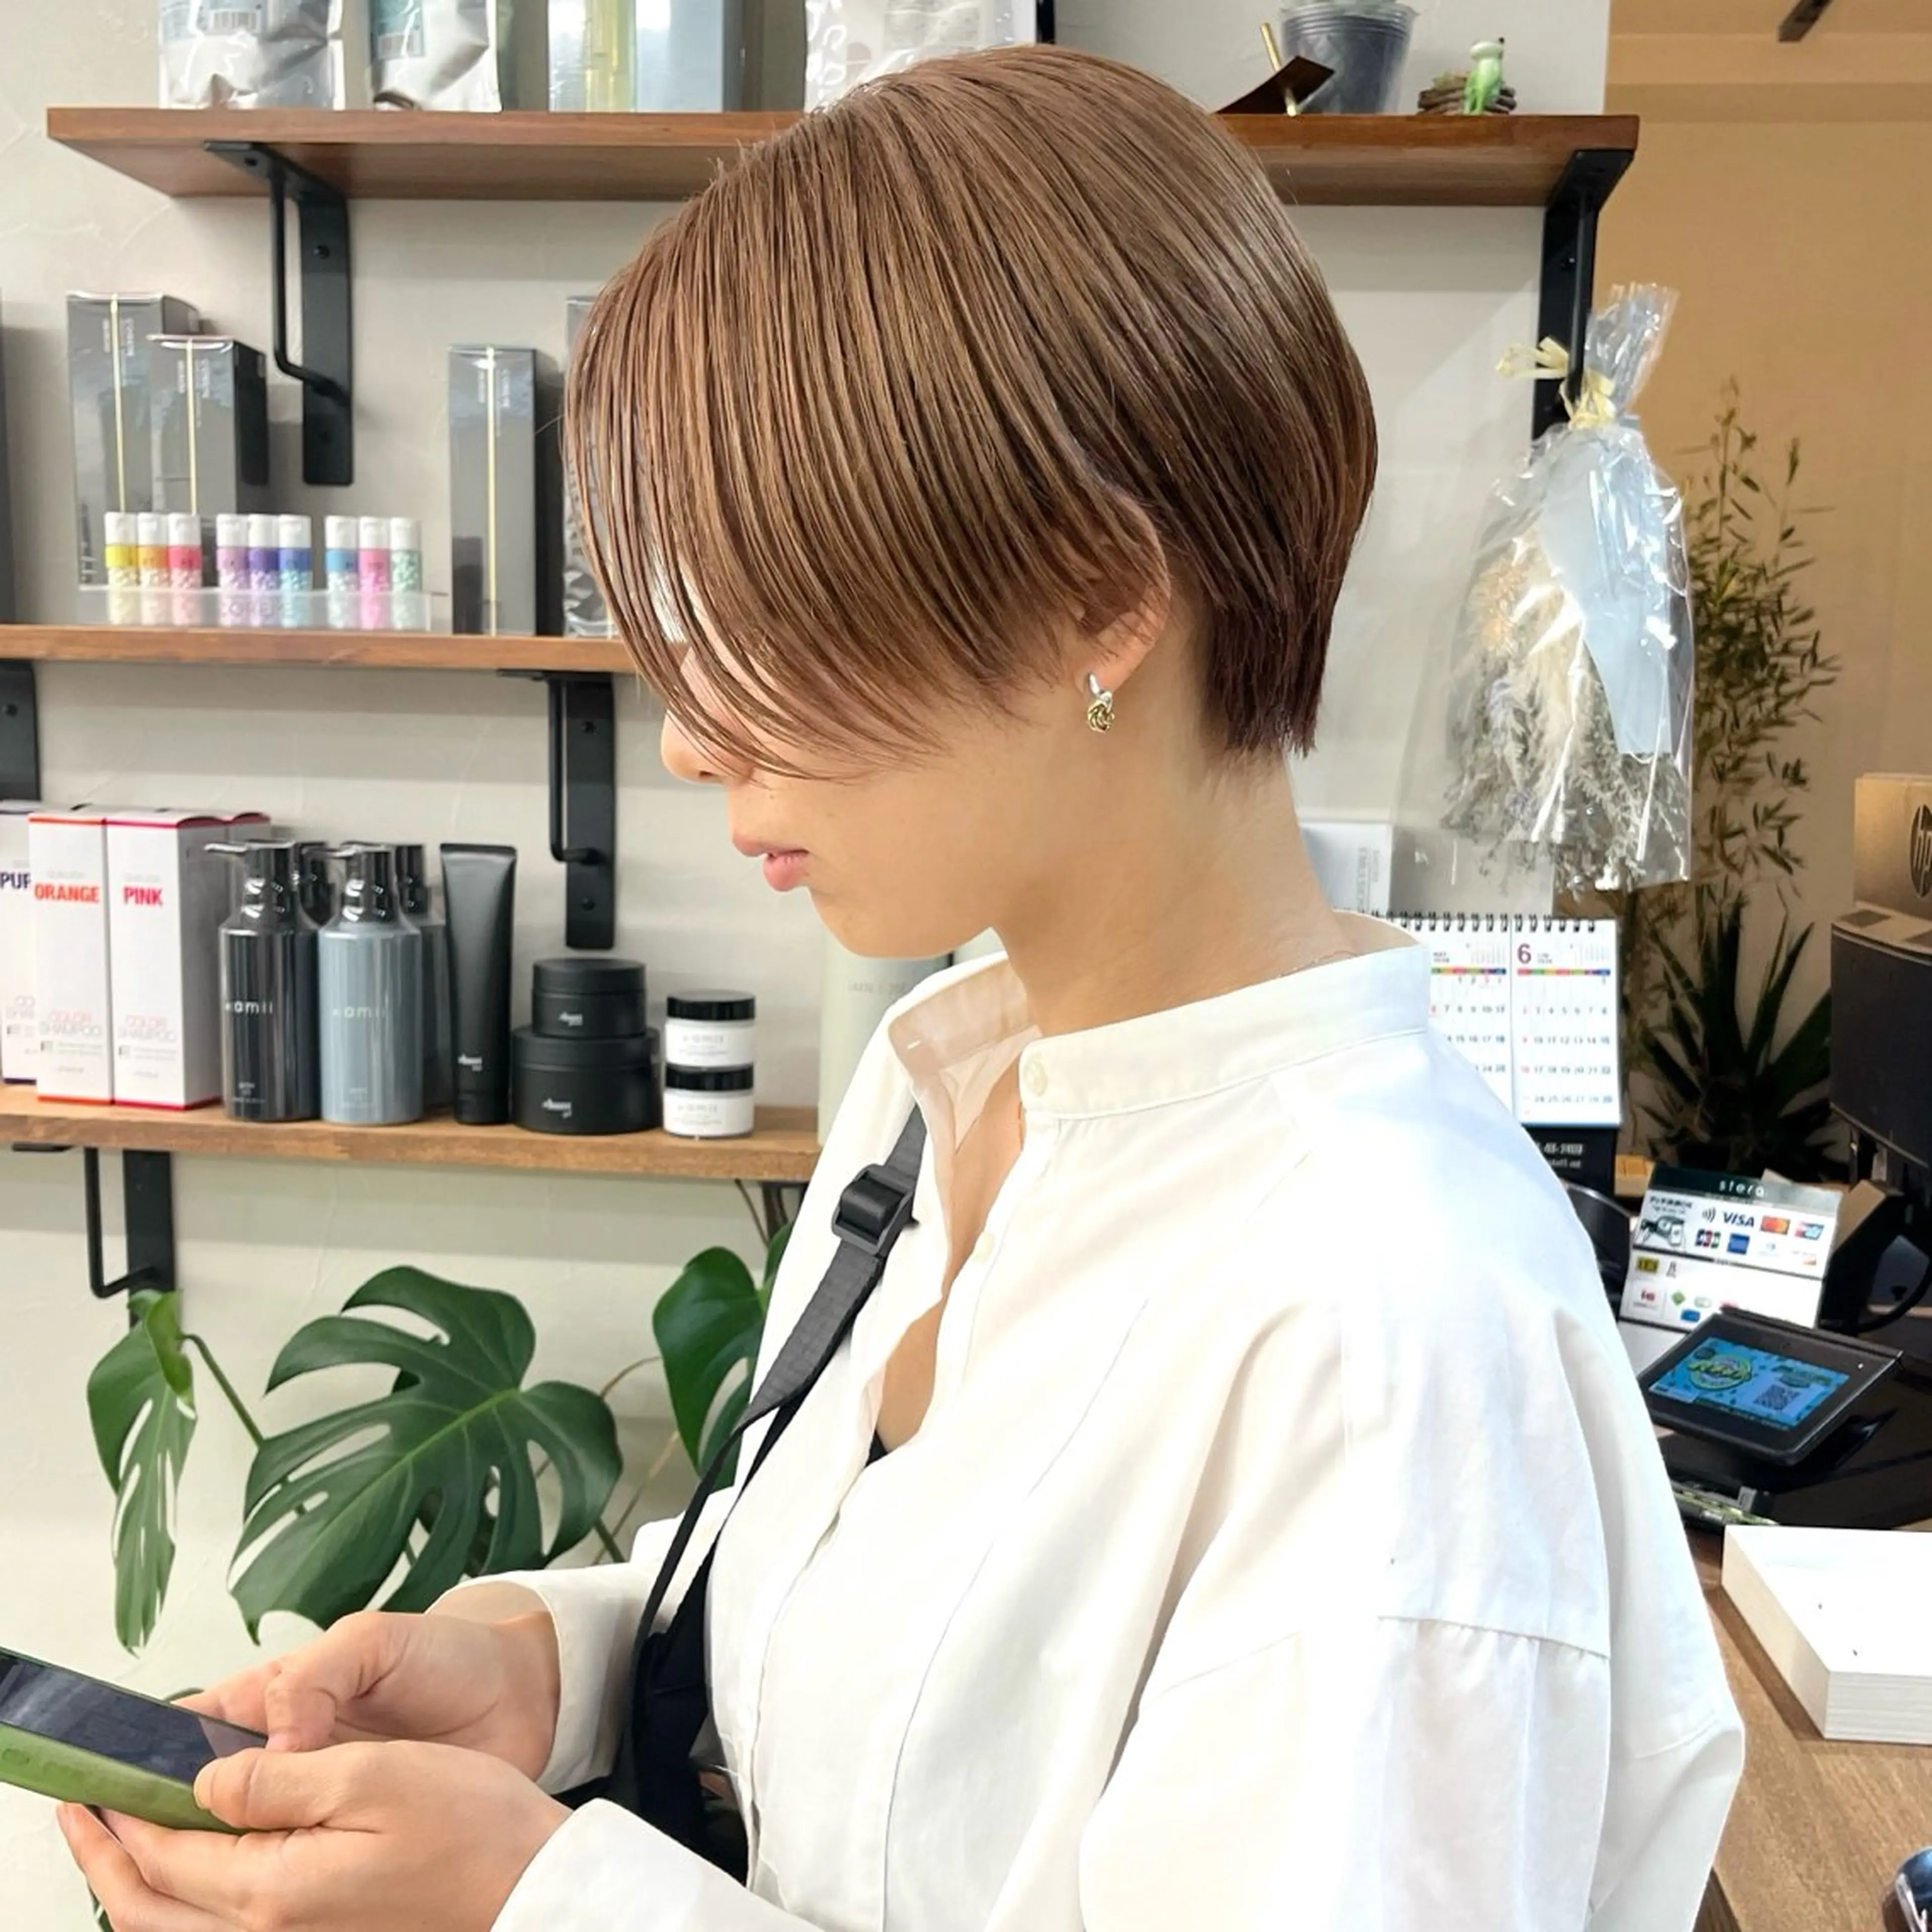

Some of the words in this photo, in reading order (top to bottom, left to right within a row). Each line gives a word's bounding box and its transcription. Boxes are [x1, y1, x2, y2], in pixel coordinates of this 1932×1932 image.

[35, 883, 100, 903] ORANGE
[124, 887, 164, 906] PINK
[1517, 942, 1531, 964] 6
[1719, 1180, 1764, 1197] stera
[1722, 1211, 1754, 1228] VISA
